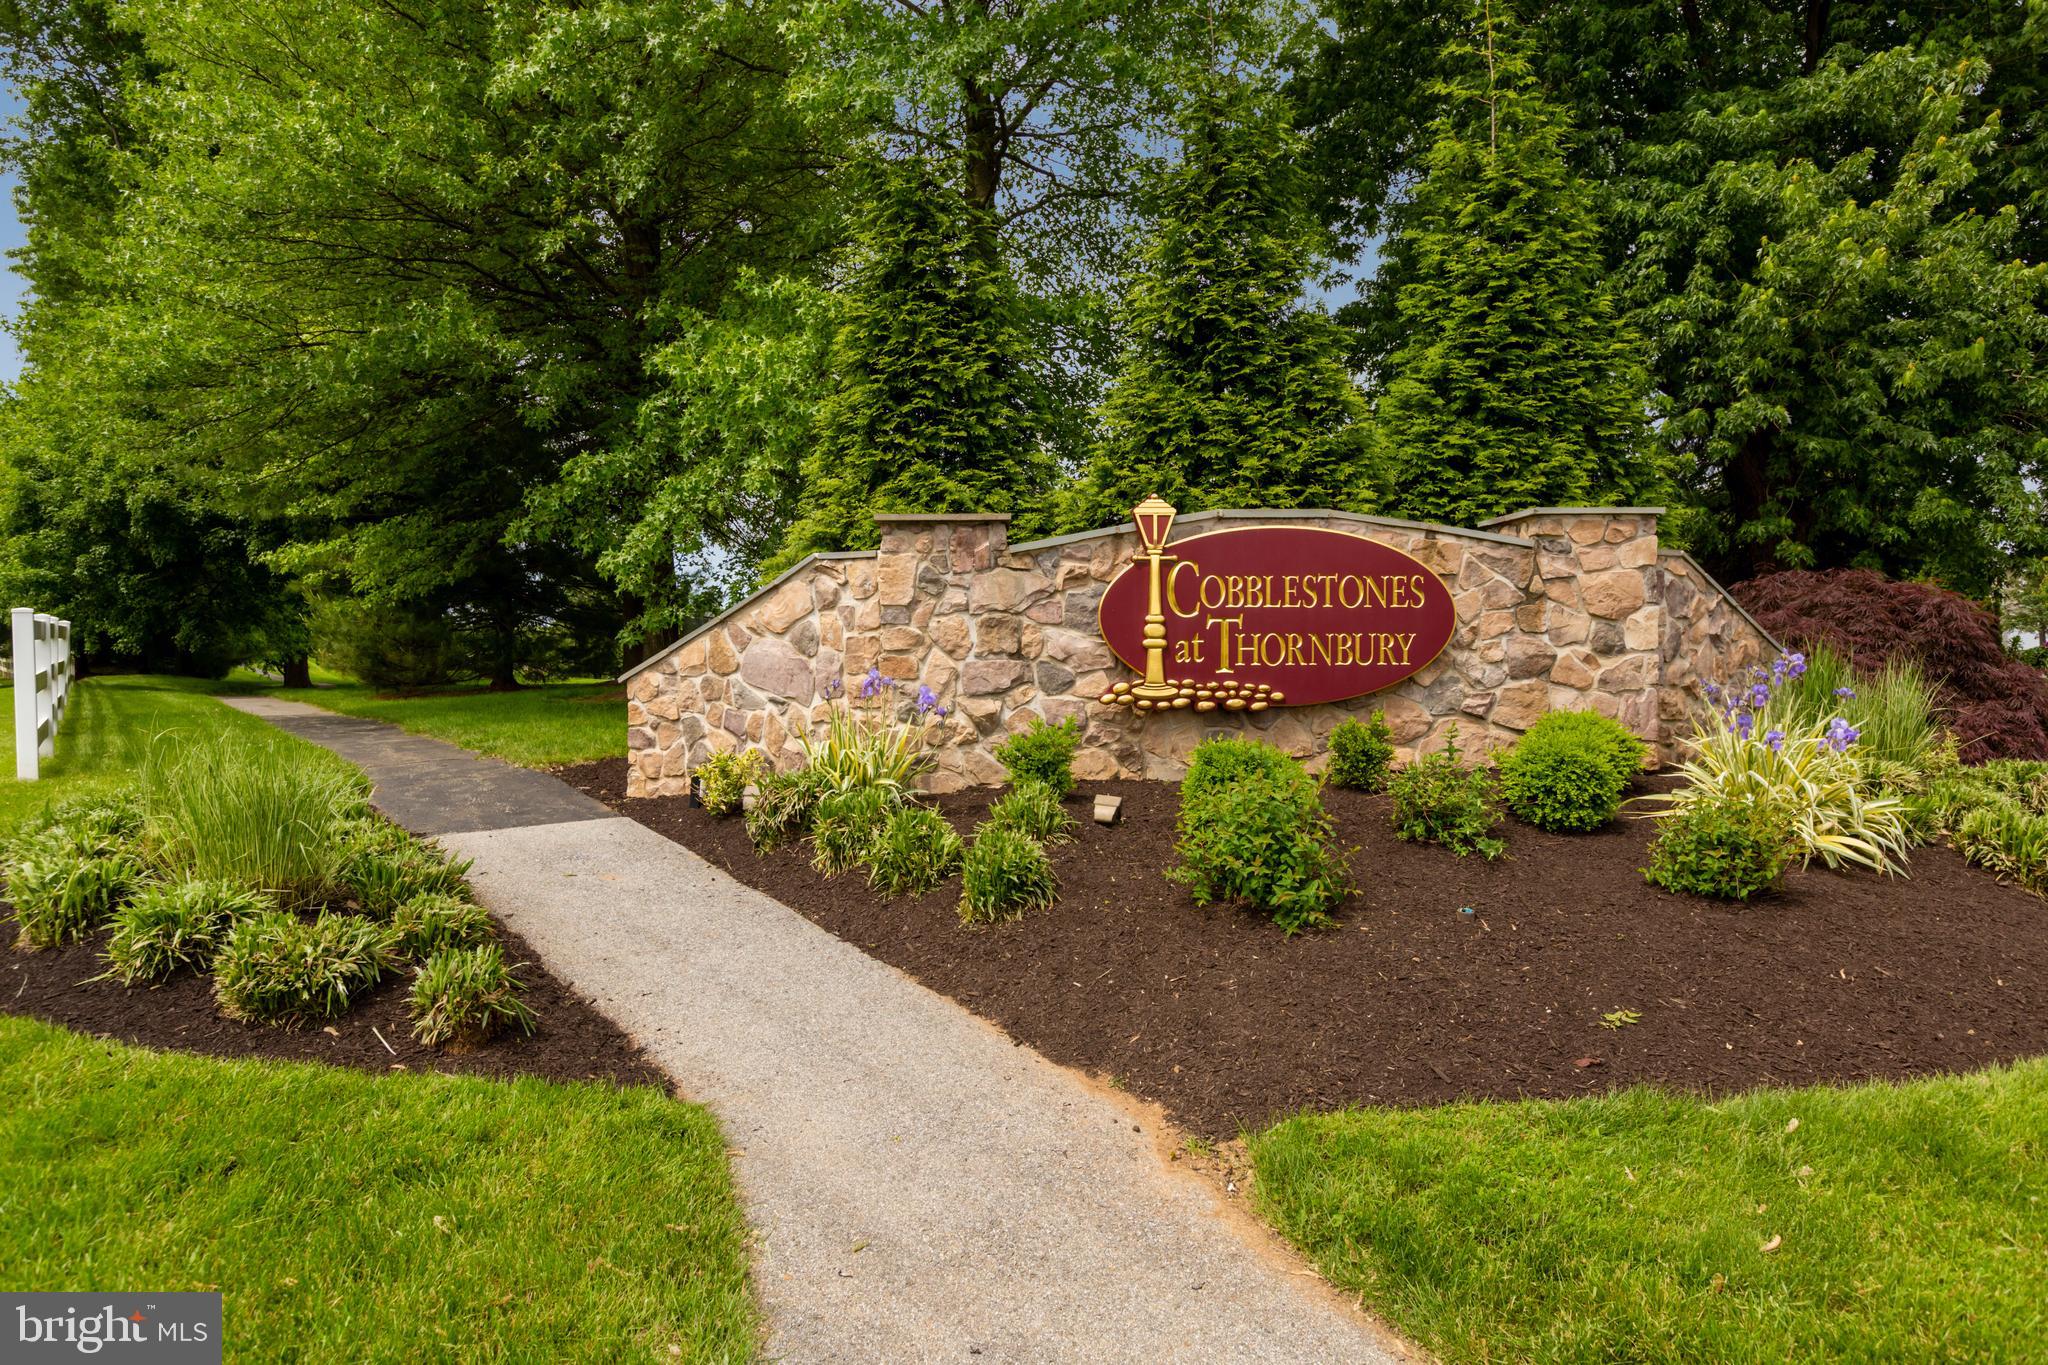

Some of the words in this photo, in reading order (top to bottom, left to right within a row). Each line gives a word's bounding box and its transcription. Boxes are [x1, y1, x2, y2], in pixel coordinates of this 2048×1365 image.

[1167, 560, 1425, 618] COBBLESTONES
[1175, 632, 1205, 663] at
[1206, 613, 1417, 674] THORNBURY
